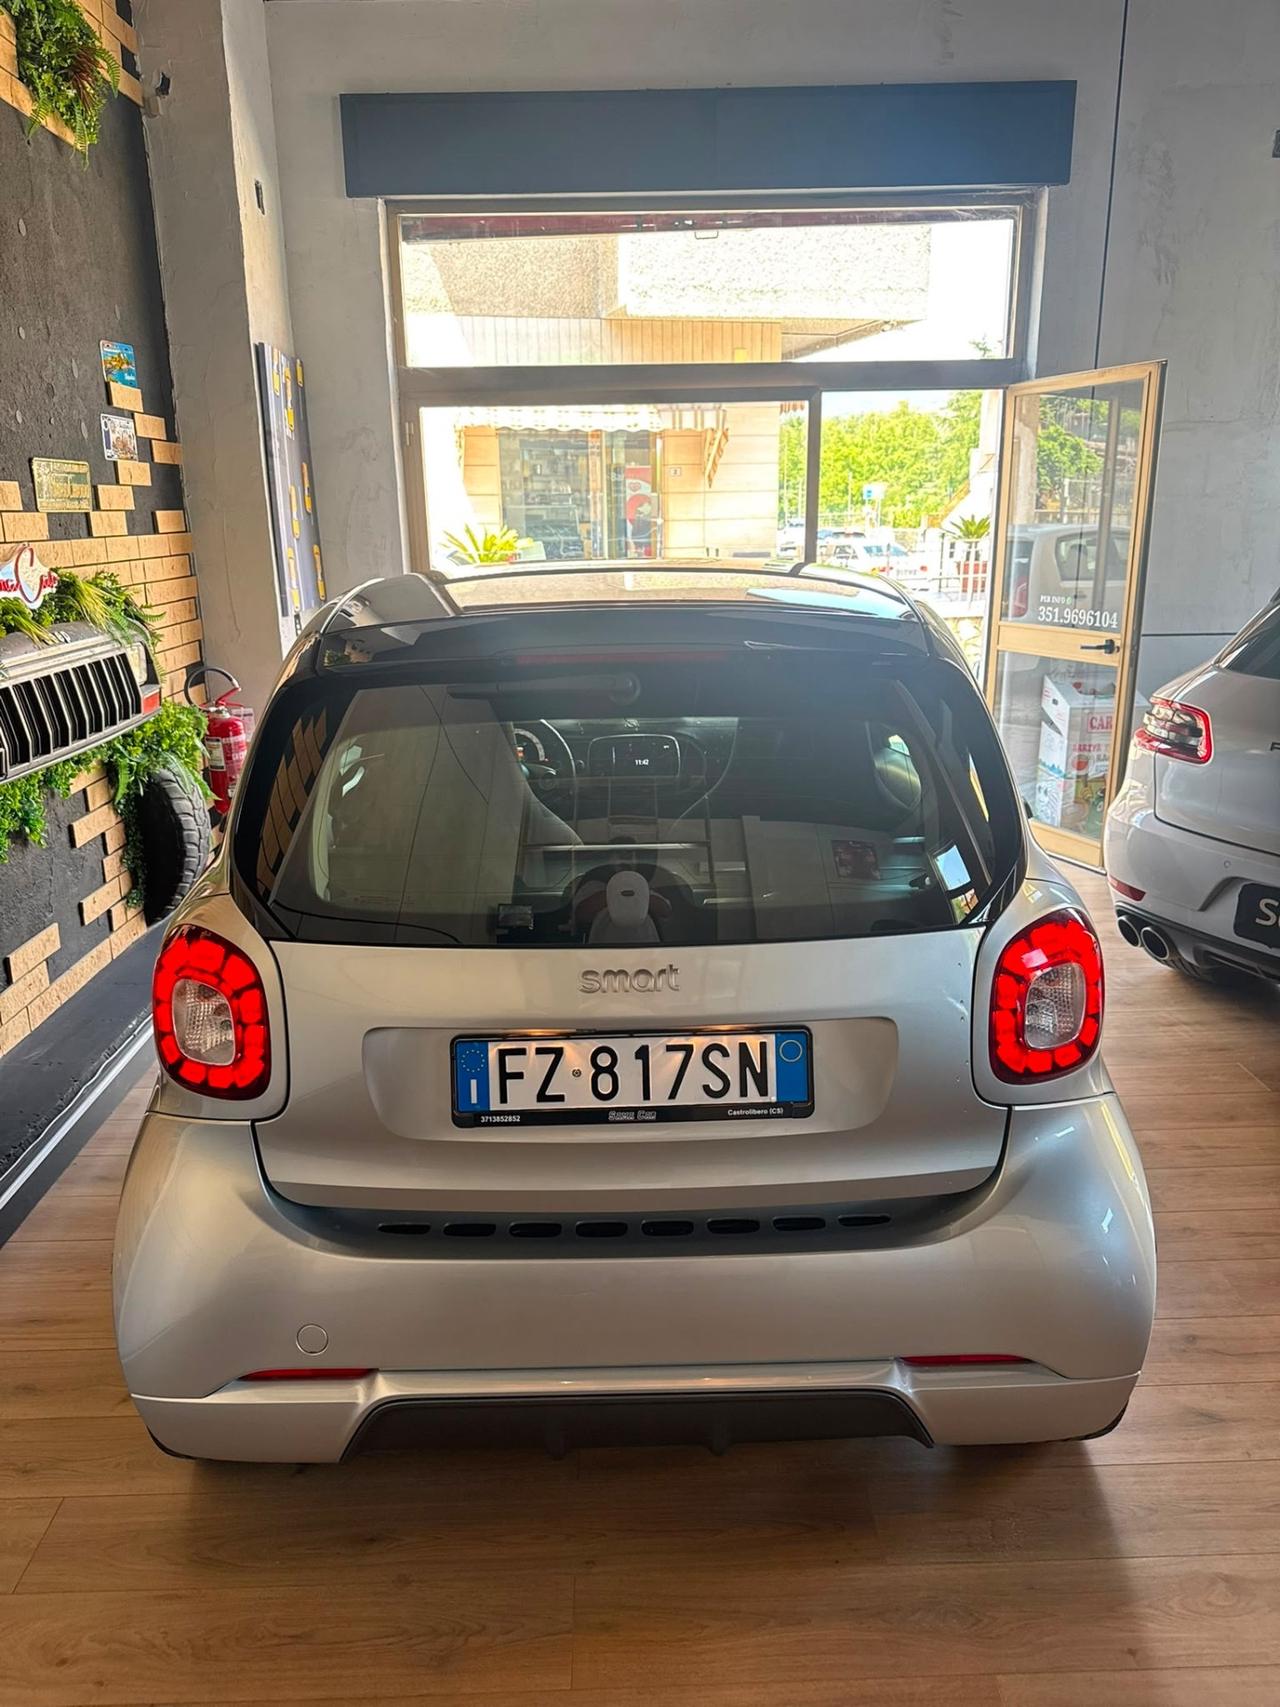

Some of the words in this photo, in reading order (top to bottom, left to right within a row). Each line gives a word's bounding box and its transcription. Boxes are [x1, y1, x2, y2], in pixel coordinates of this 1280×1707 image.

[1038, 606, 1118, 629] 351.9696104
[1255, 898, 1280, 927] S
[578, 964, 680, 993] smart
[498, 1046, 566, 1105] FZ
[590, 1041, 769, 1102] 817SN
[769, 1107, 784, 1115] (CS)
